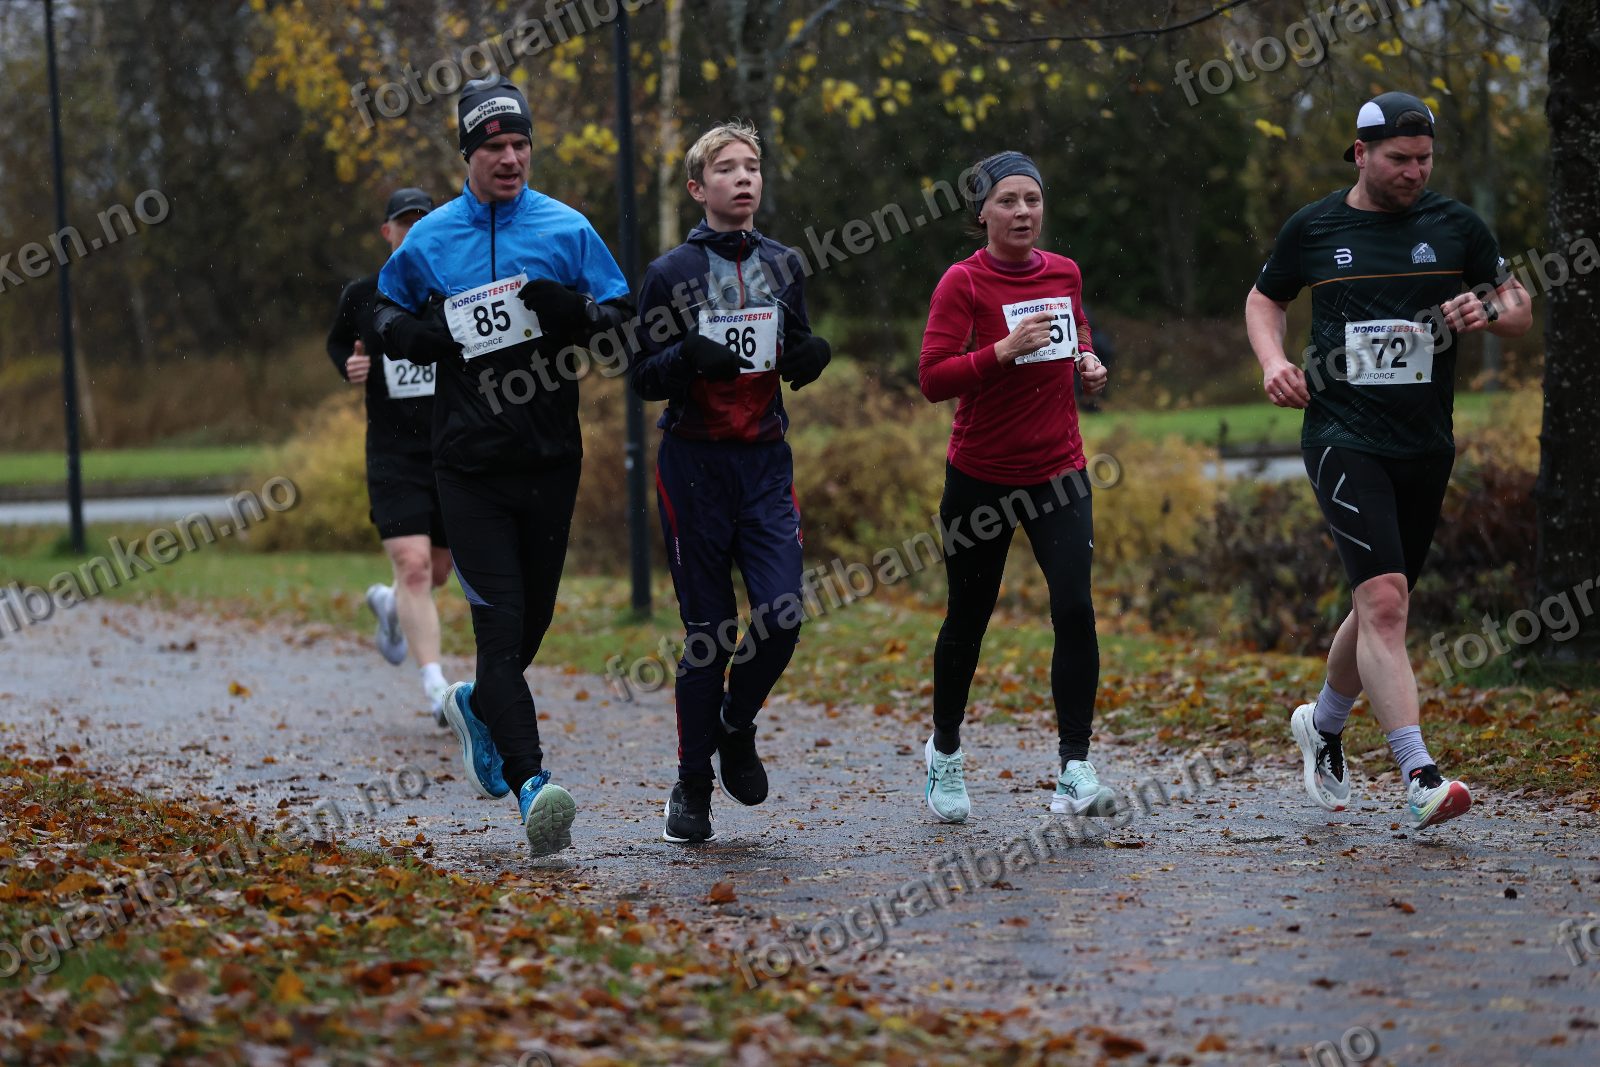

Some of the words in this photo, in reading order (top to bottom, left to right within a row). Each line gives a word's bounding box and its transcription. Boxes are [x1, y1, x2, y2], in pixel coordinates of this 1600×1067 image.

[468, 105, 515, 128] Sportslager
[477, 100, 497, 112] Oslo
[451, 281, 522, 311] NORGESTESTEN
[473, 300, 511, 337] 85
[706, 312, 773, 324] NORGESTESTEN
[725, 326, 757, 358] 86
[1371, 337, 1407, 369] 72
[395, 363, 435, 386] 228
